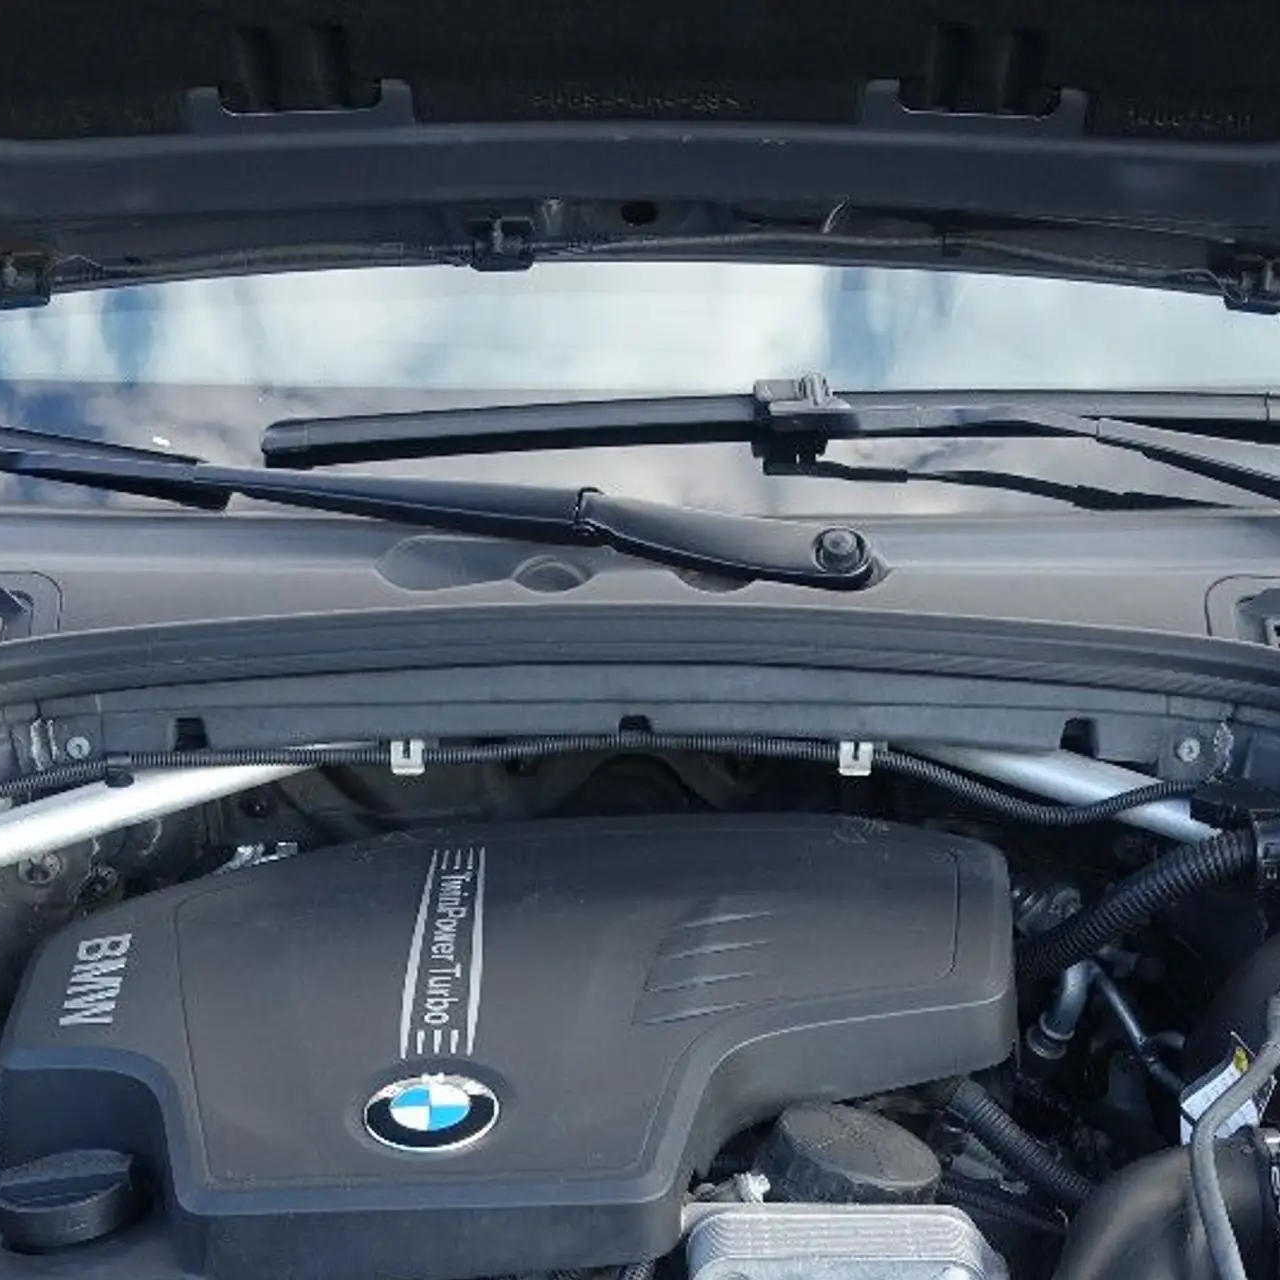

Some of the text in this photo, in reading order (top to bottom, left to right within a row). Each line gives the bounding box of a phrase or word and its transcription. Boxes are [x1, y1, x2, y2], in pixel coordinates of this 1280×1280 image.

[59, 933, 132, 1026] BMW
[424, 871, 472, 1025] TwinPower Turbo
